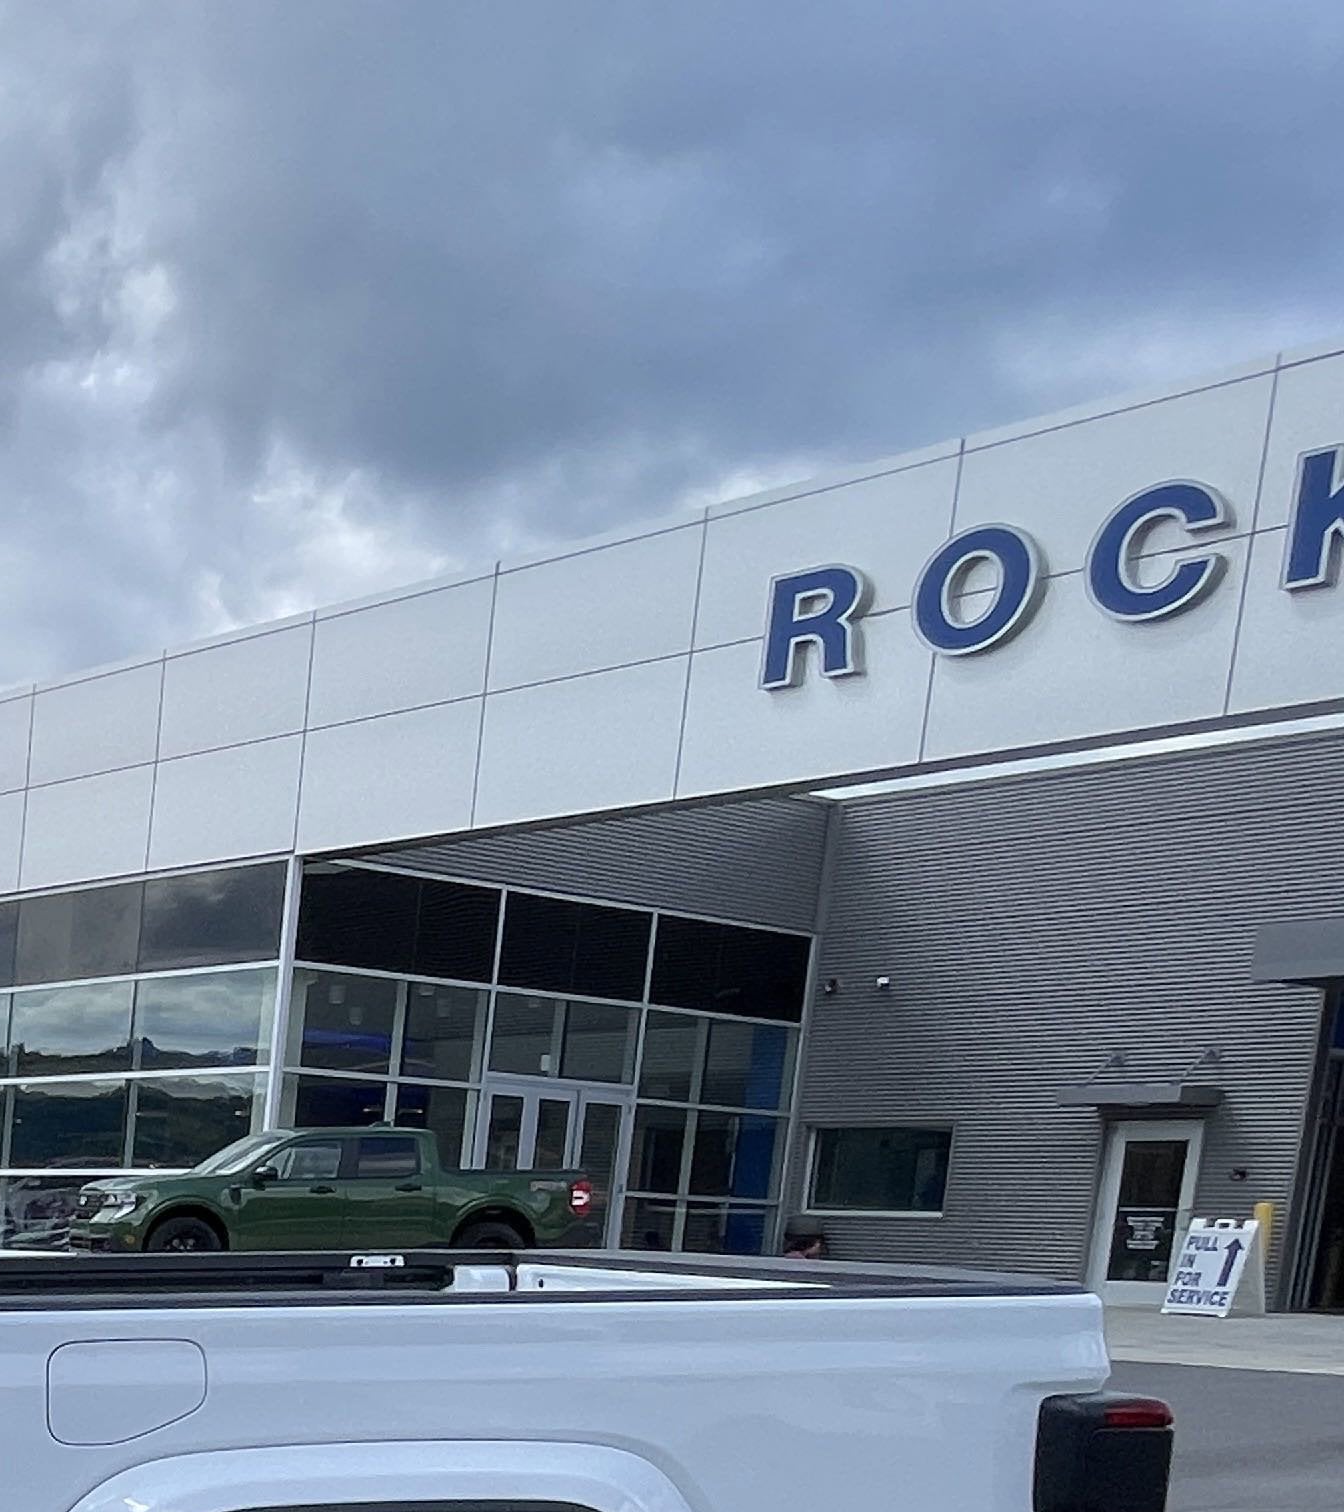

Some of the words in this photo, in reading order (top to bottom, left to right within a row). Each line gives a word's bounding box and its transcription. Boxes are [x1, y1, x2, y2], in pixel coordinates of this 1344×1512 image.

[1186, 1235, 1218, 1251] PULL
[1180, 1253, 1197, 1268] IN
[1175, 1271, 1202, 1286] FOR
[1167, 1289, 1230, 1307] SERVICE
